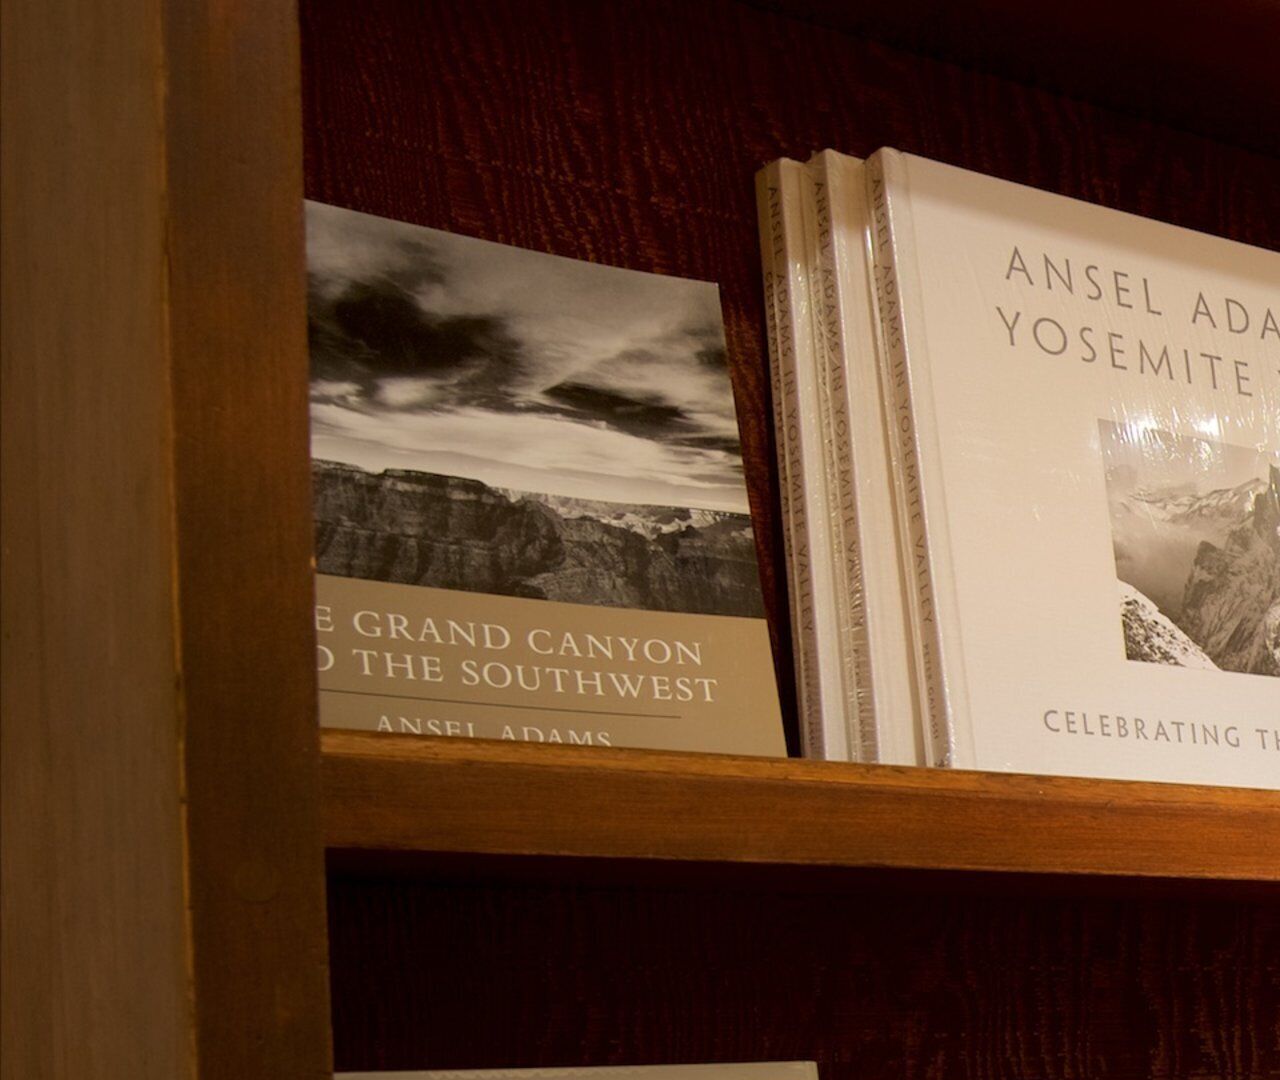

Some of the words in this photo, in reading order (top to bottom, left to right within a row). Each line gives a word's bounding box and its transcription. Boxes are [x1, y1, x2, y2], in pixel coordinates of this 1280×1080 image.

[767, 186, 784, 257] ANSEL
[814, 181, 831, 255] ANSEL
[872, 179, 890, 251] ANSEL
[776, 273, 792, 357] ADAMS
[822, 269, 840, 350] ADAMS
[884, 265, 900, 348] ADAMS
[1005, 246, 1162, 316] ANSEL
[783, 369, 795, 397] IN
[832, 366, 842, 392] IN
[895, 361, 905, 388] IN
[996, 306, 1253, 397] YOSEMITE
[786, 407, 806, 530] YOSEMITE
[835, 402, 856, 526] YOSEMITE
[899, 399, 921, 521] YOSEMITE
[798, 545, 814, 632] VALLEY
[915, 536, 933, 623] VALLEY
[352, 610, 511, 649] GRAND
[527, 629, 702, 666] CANYON
[352, 648, 443, 682] THE
[461, 659, 718, 702] SOUTHWEST
[1043, 709, 1240, 748] CELEBRATING
